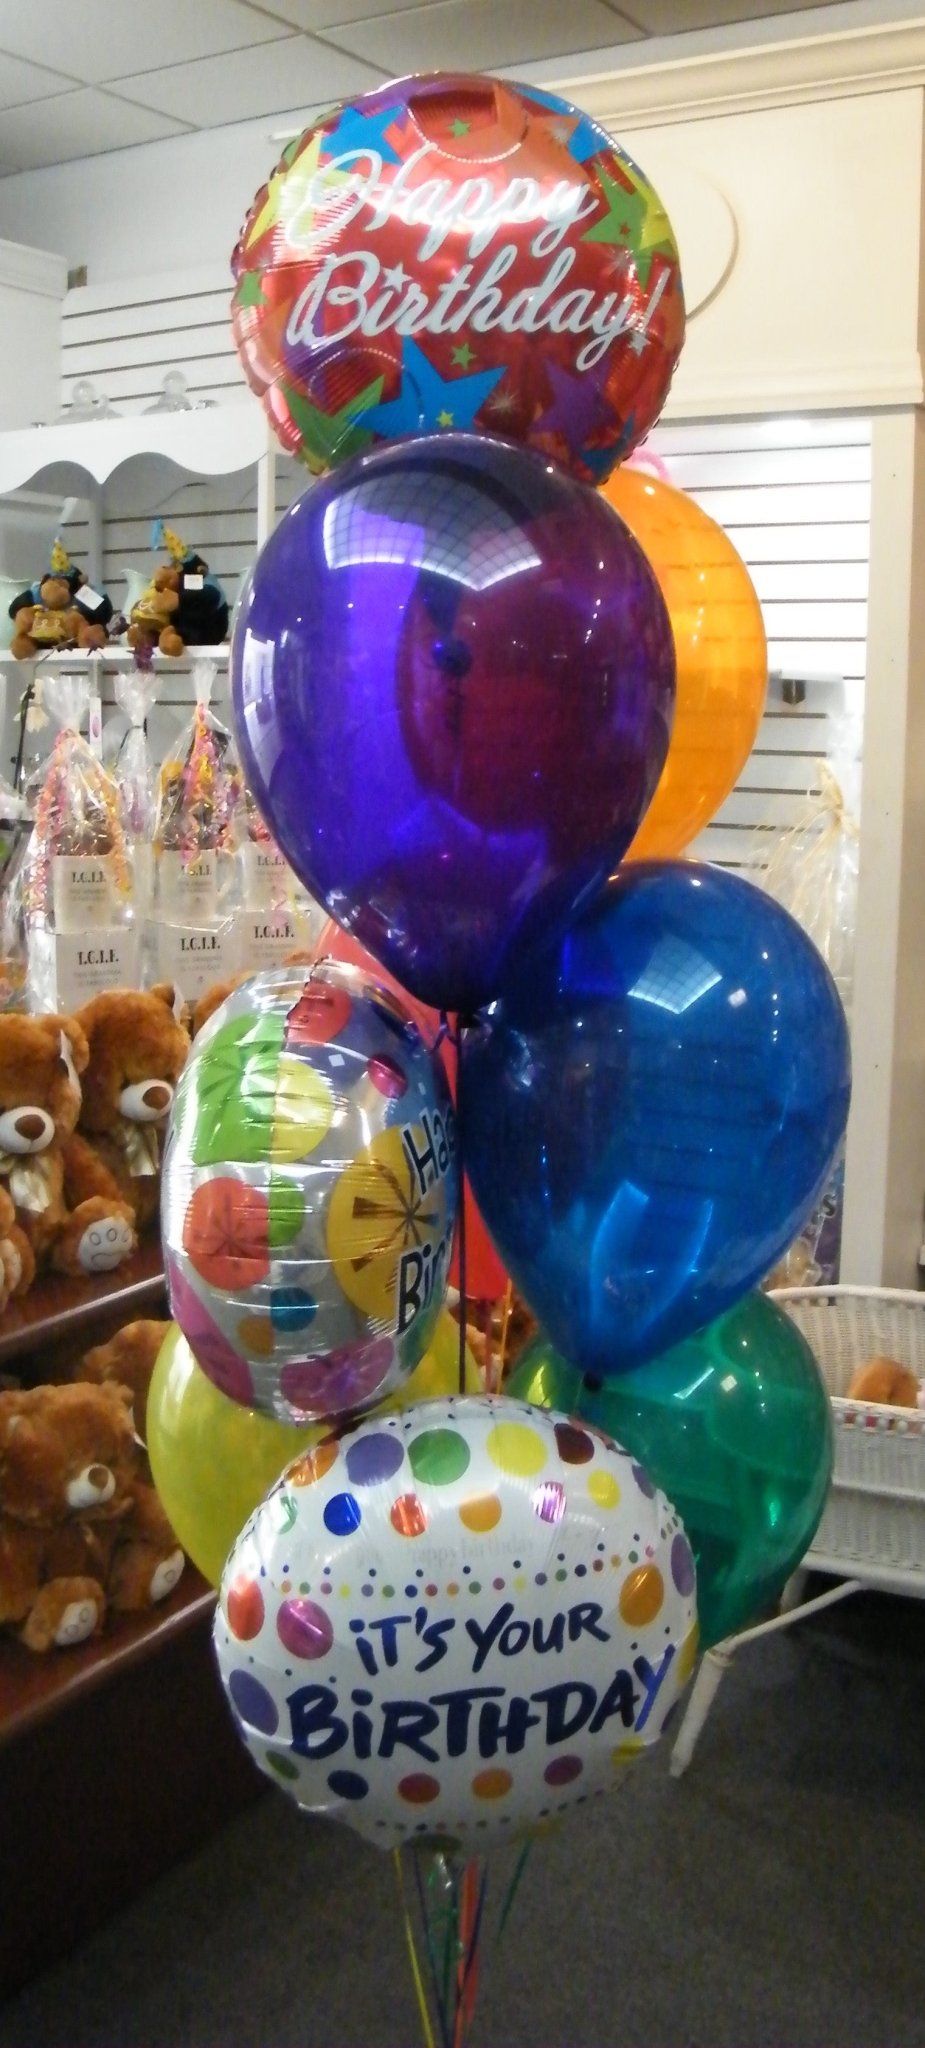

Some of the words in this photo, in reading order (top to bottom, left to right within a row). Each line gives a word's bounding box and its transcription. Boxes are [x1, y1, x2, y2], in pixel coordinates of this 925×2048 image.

[284, 140, 600, 263] Happy
[285, 244, 672, 372] Birthday!
[397, 1226, 450, 1334] Bir
